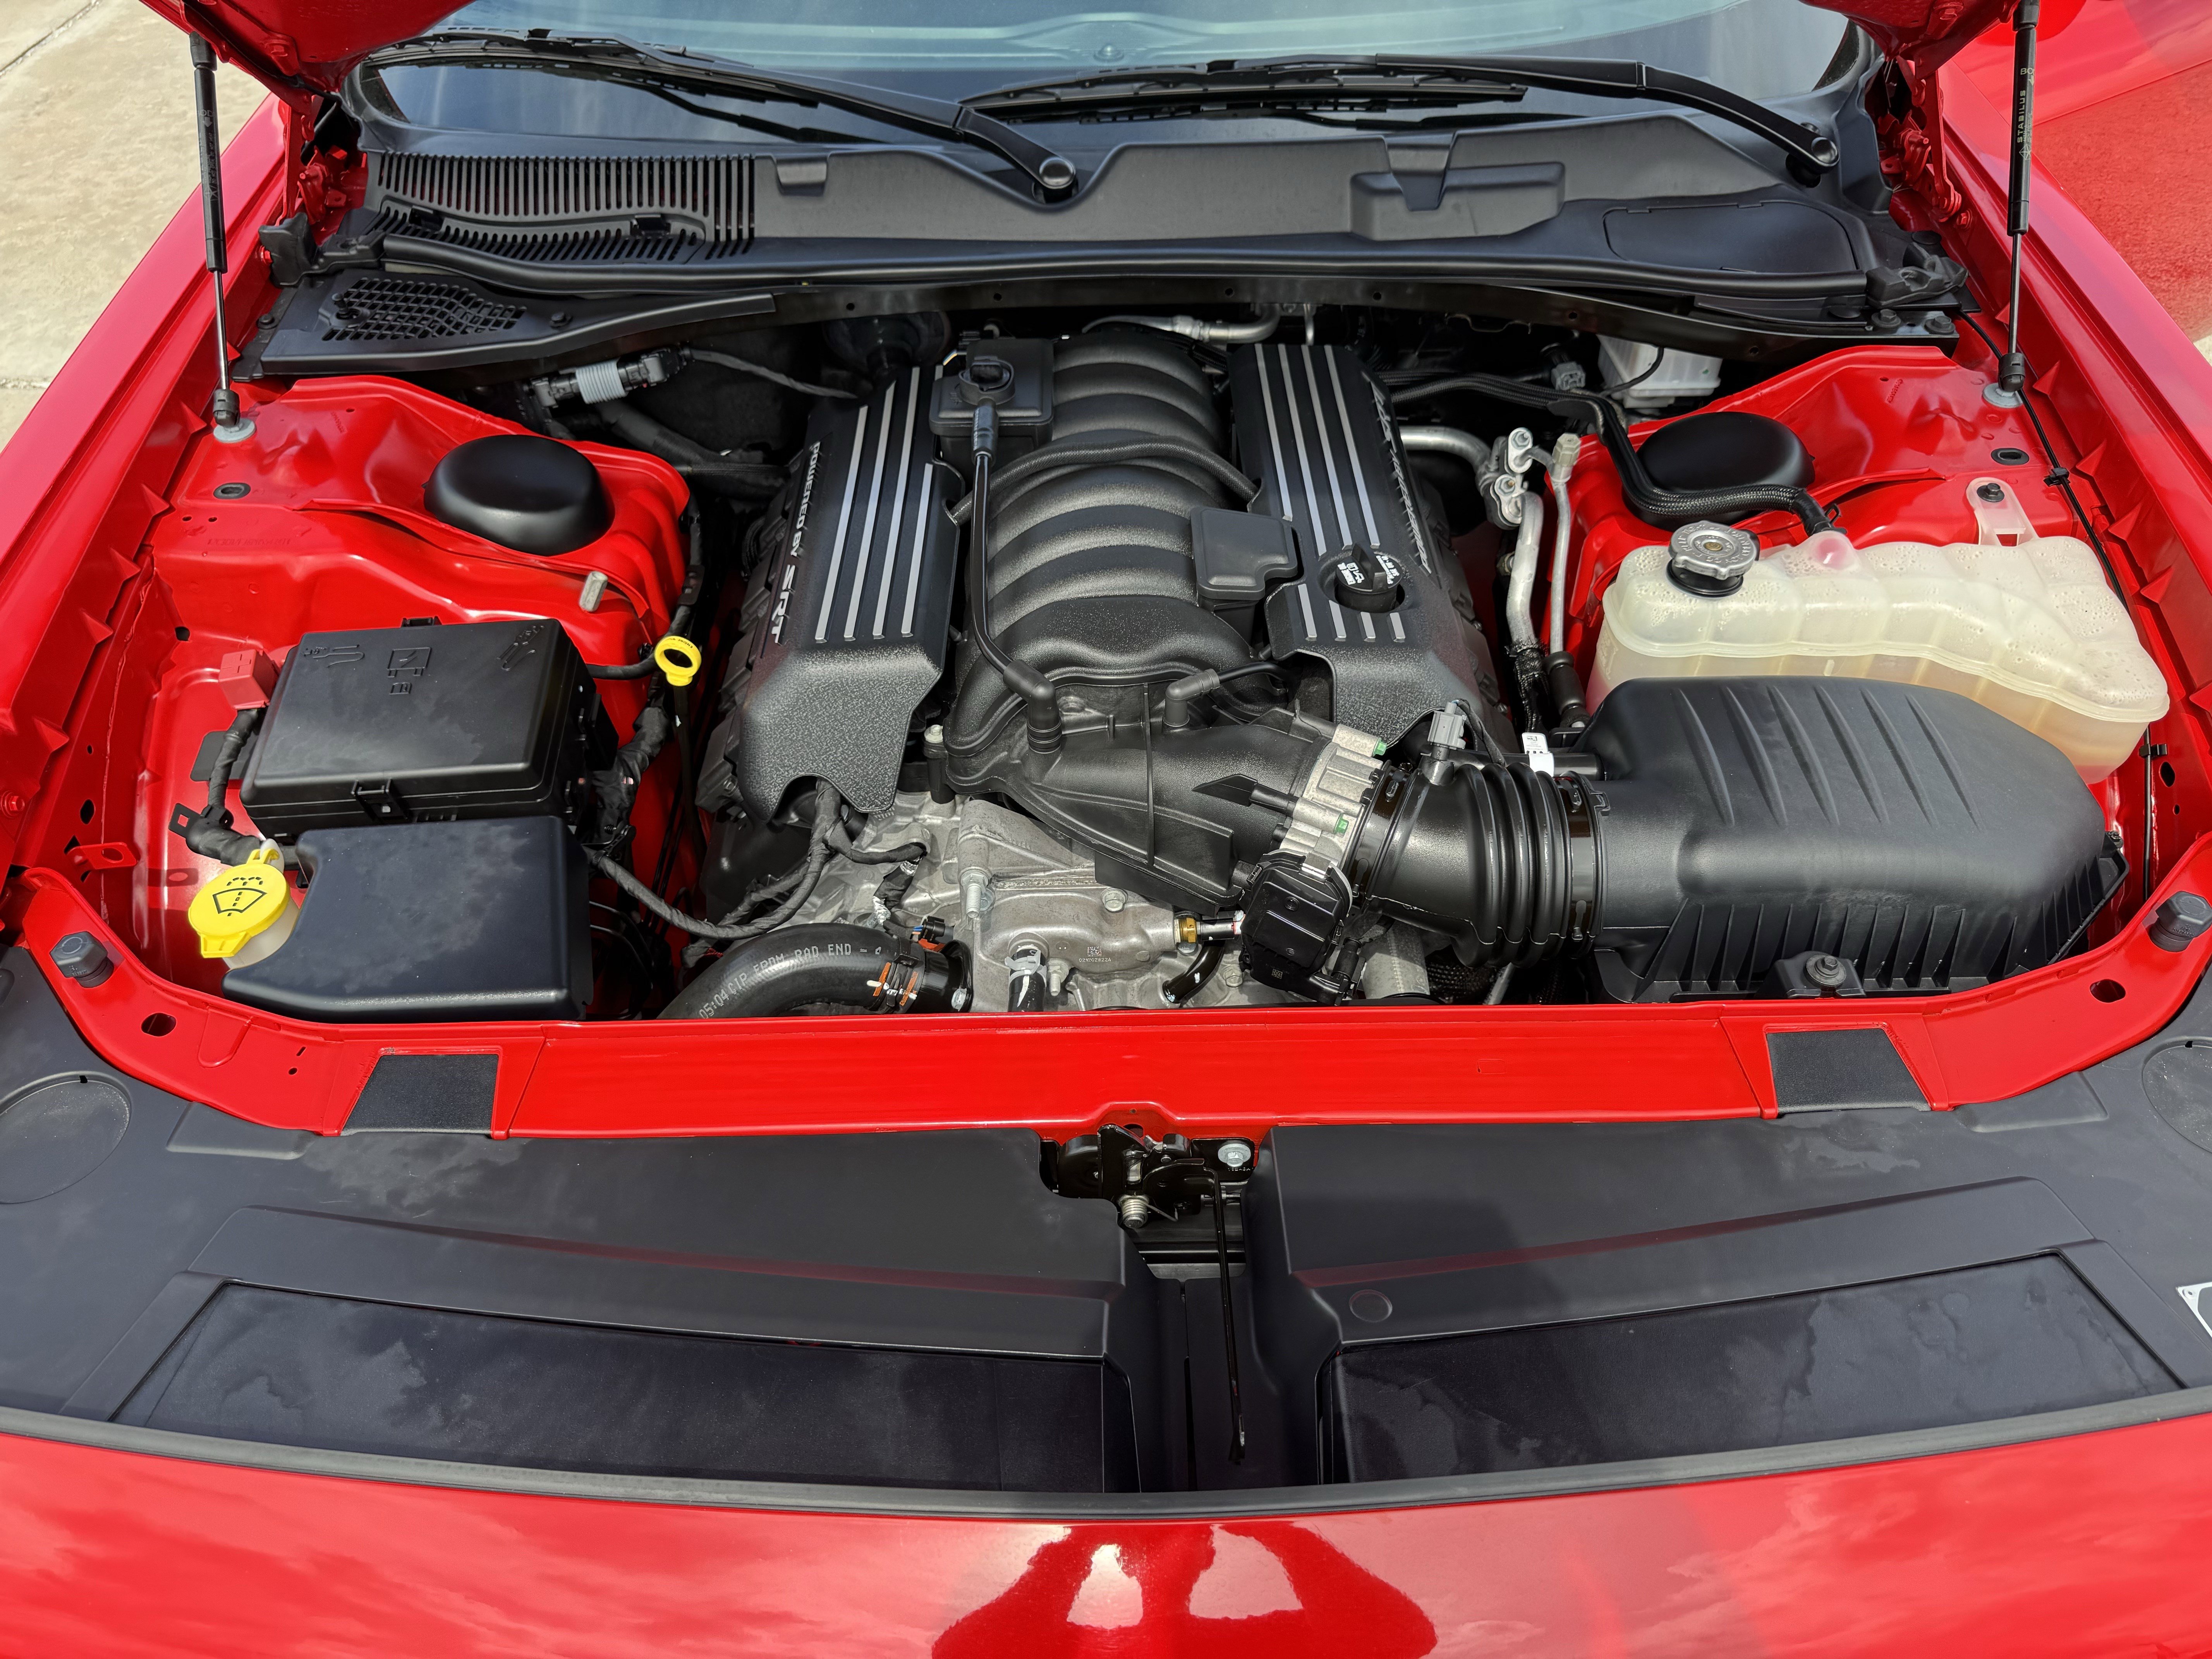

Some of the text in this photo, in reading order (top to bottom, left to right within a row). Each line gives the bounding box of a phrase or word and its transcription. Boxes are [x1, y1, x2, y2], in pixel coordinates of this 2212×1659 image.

[2017, 90, 2026, 143] STABILUS
[771, 441, 820, 644] POWERED BY SRT
[794, 946, 819, 961] RAD
[828, 943, 851, 956] END
